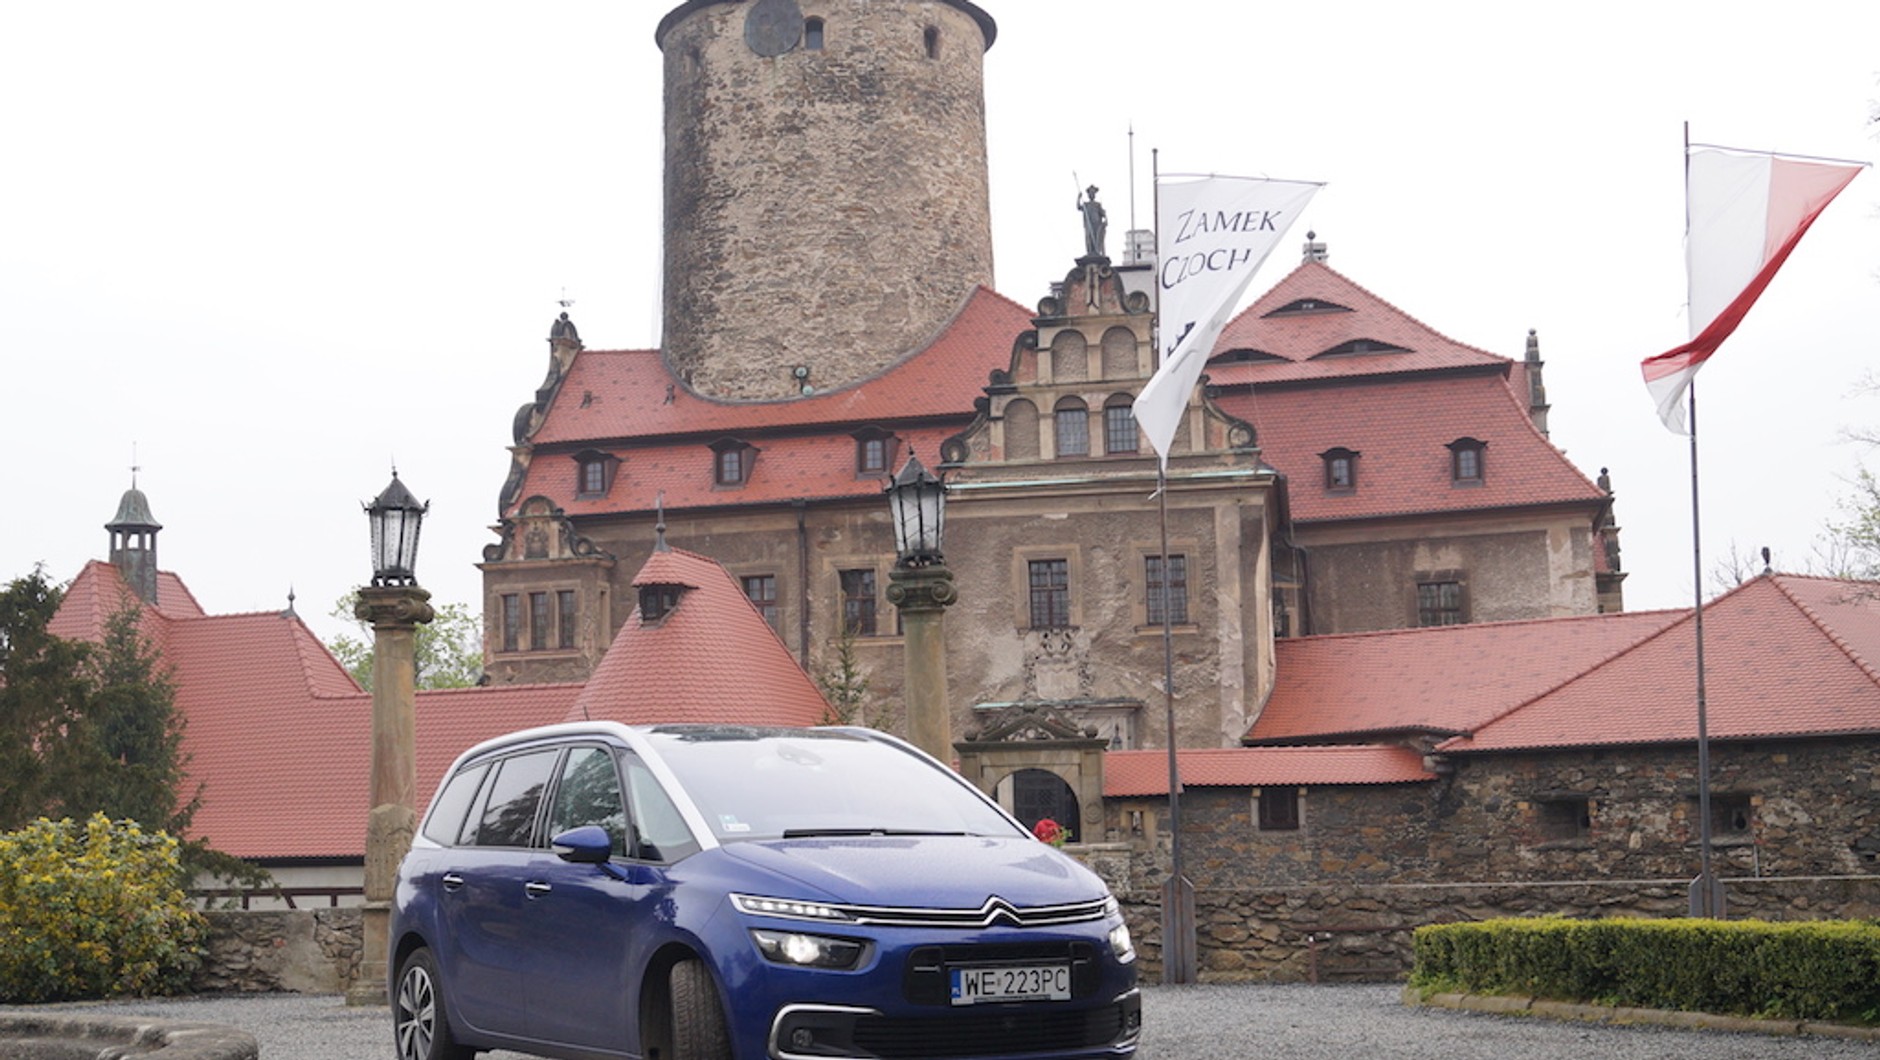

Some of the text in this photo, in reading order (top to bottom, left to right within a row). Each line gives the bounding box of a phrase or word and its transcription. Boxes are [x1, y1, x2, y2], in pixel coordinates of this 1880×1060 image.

[1175, 208, 1282, 243] ZAMEK
[1162, 248, 1251, 289] CZOCH
[965, 969, 1066, 995] WE 223PC
